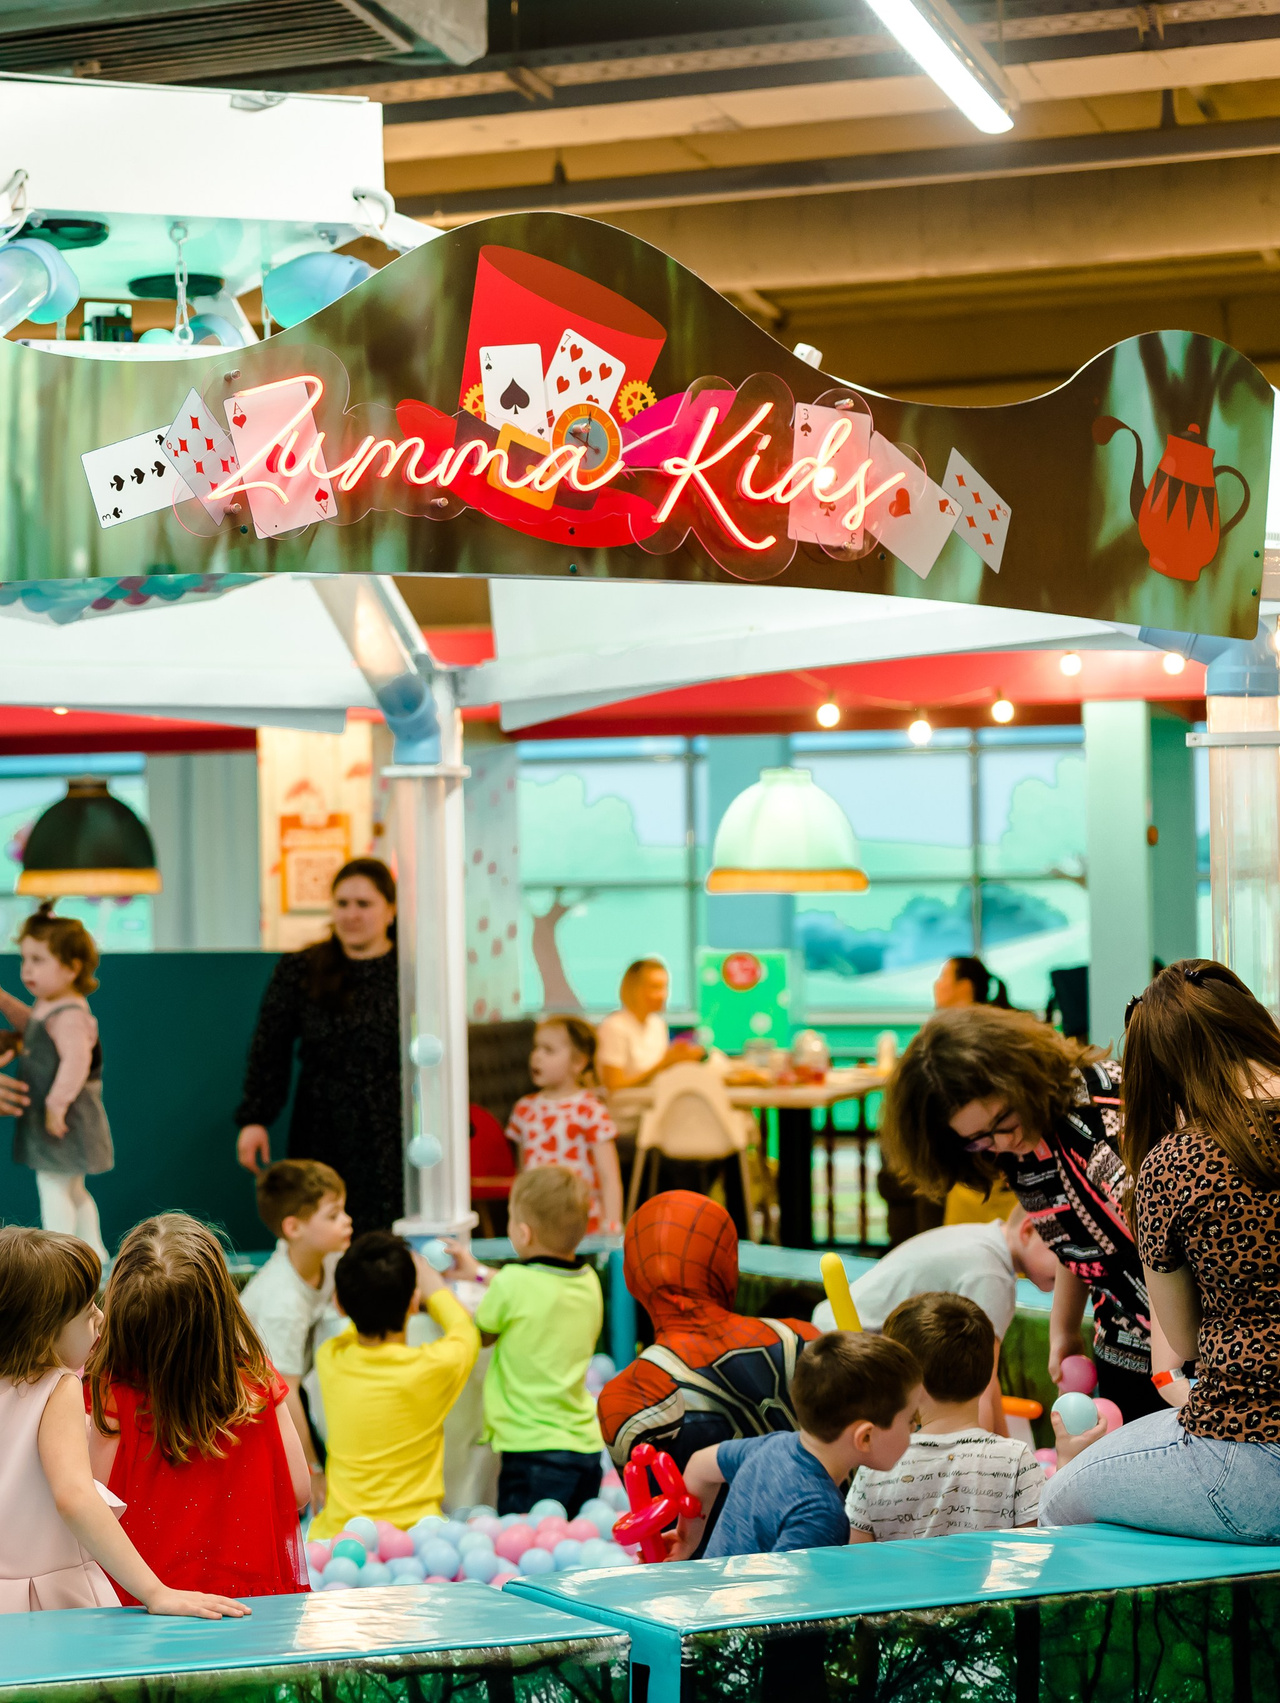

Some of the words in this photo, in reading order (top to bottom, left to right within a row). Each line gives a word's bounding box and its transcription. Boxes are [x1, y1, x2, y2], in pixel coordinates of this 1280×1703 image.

[484, 352, 492, 361] A
[232, 401, 244, 415] A
[205, 374, 625, 504] Zumma
[650, 401, 907, 550] Kids
[946, 1505, 971, 1515] JUST
